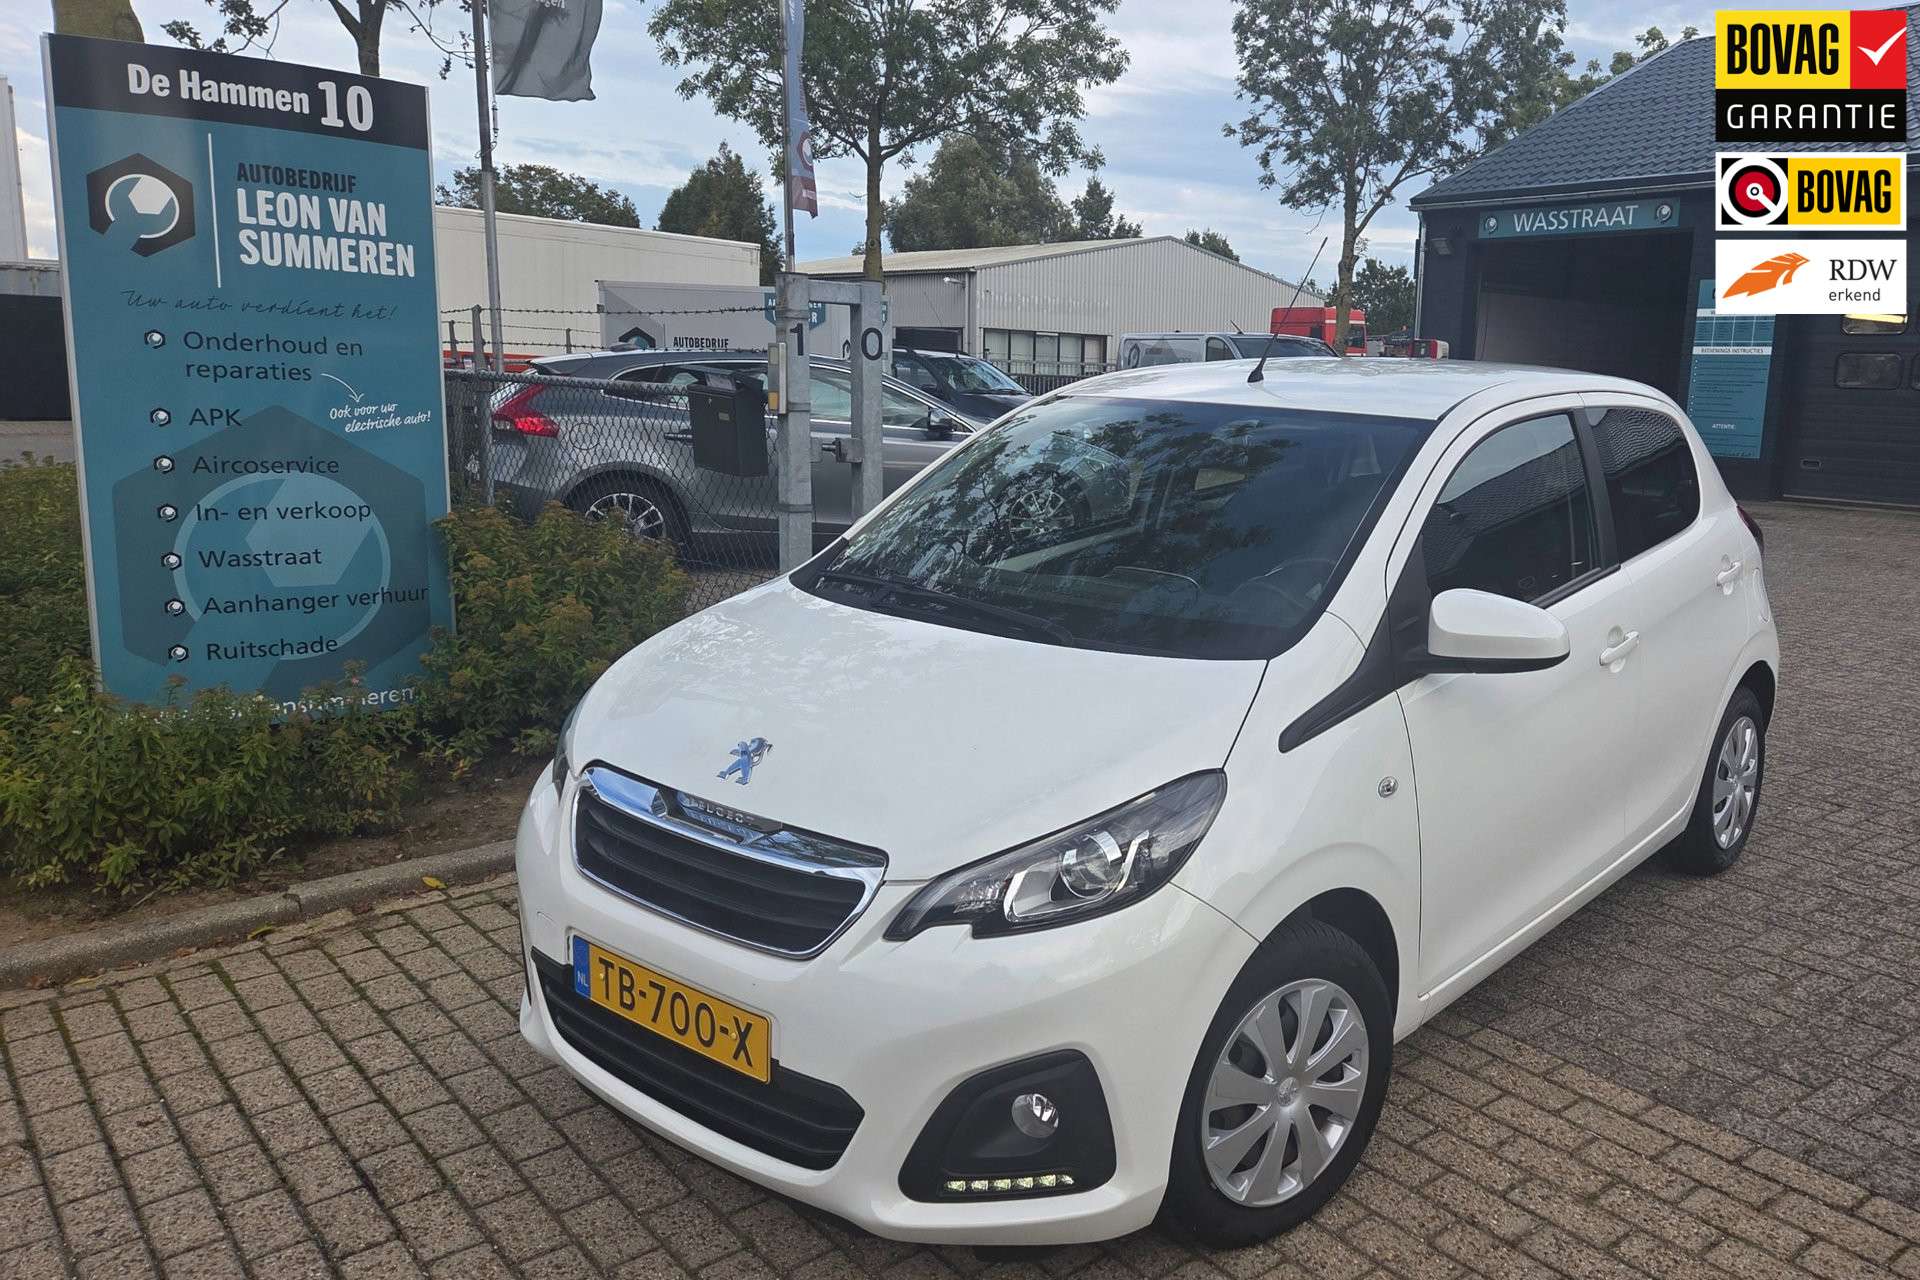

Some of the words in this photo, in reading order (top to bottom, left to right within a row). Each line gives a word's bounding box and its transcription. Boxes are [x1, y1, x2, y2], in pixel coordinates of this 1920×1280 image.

[127, 63, 170, 97] De
[178, 69, 310, 114] Hammen
[318, 80, 374, 132] 10
[236, 162, 357, 194] AUTOBEDRIJF
[236, 188, 321, 231] LEON
[328, 198, 387, 237] VAN
[1513, 205, 1639, 233] WASSTRAAT
[239, 230, 415, 278] SUMMEREN
[121, 290, 167, 308] Uw
[174, 295, 233, 312] auto
[241, 299, 345, 318] verdient
[351, 303, 398, 320] het!
[183, 331, 327, 355] Onderhoud
[336, 340, 363, 356] en
[673, 336, 729, 349] AUTOBEDRIJF
[789, 322, 804, 356] 1
[861, 327, 883, 361] 0
[186, 361, 312, 383] reparaties
[189, 408, 242, 426] APK
[329, 404, 352, 420] Ook
[354, 404, 379, 416] voor
[381, 403, 398, 413] uw
[345, 412, 402, 433] electrische
[403, 410, 431, 425] auto!
[192, 455, 340, 474] Aircoservice
[196, 503, 228, 521] In-
[238, 505, 268, 521] en
[276, 501, 372, 523] verkoop
[198, 548, 322, 568] Wasstraat
[203, 591, 338, 615] Aanhanger
[346, 585, 430, 607] verhuur
[207, 636, 338, 661] Ruitschade
[576, 972, 589, 987] NL
[598, 957, 754, 1068] TB-700-X
